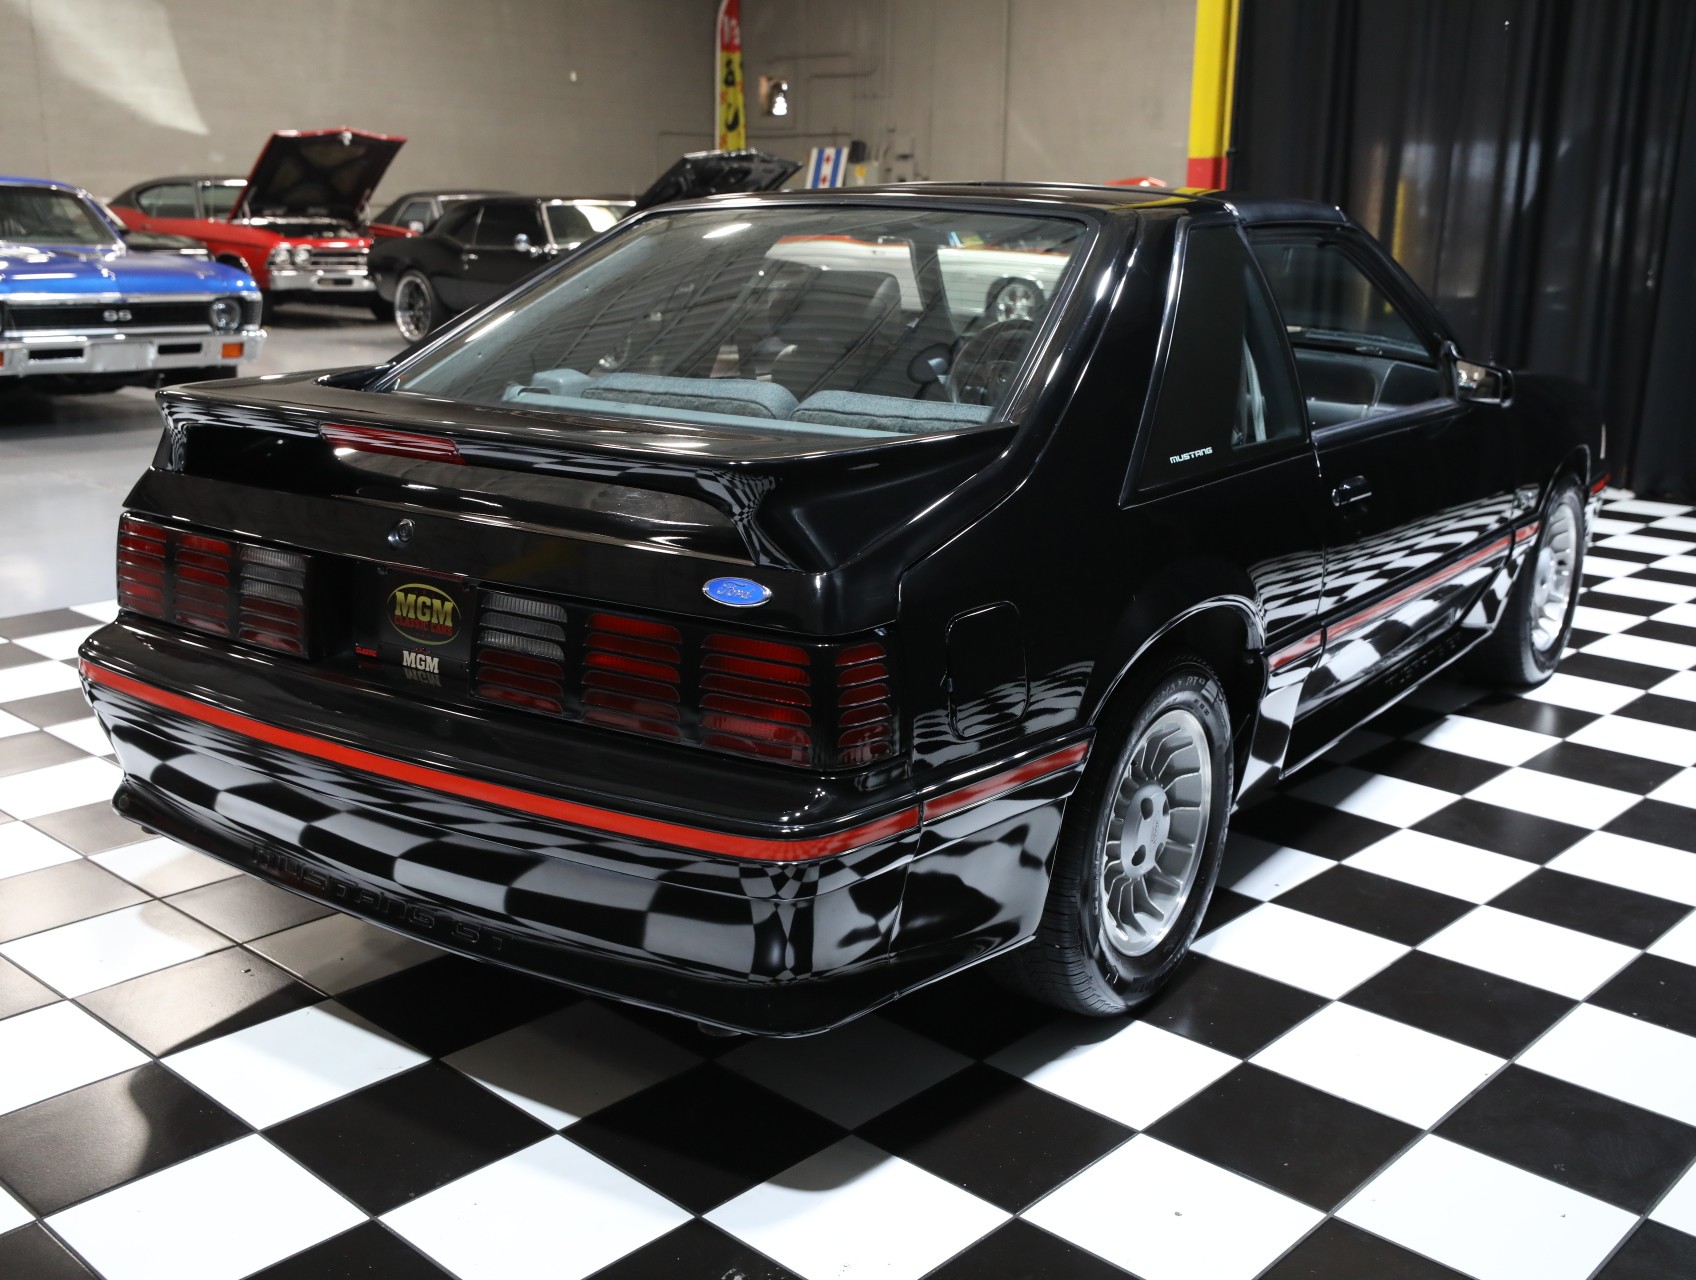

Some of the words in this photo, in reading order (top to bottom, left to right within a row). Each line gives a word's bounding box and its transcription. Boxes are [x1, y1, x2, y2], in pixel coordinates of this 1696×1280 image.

[103, 309, 133, 322] SS
[1169, 446, 1213, 464] MUSTANG
[716, 581, 756, 599] Ford
[394, 591, 454, 627] MGM
[394, 616, 430, 631] CLASSIC
[430, 623, 454, 637] CARS
[354, 646, 377, 657] CLASSIC
[402, 650, 440, 674] MGM
